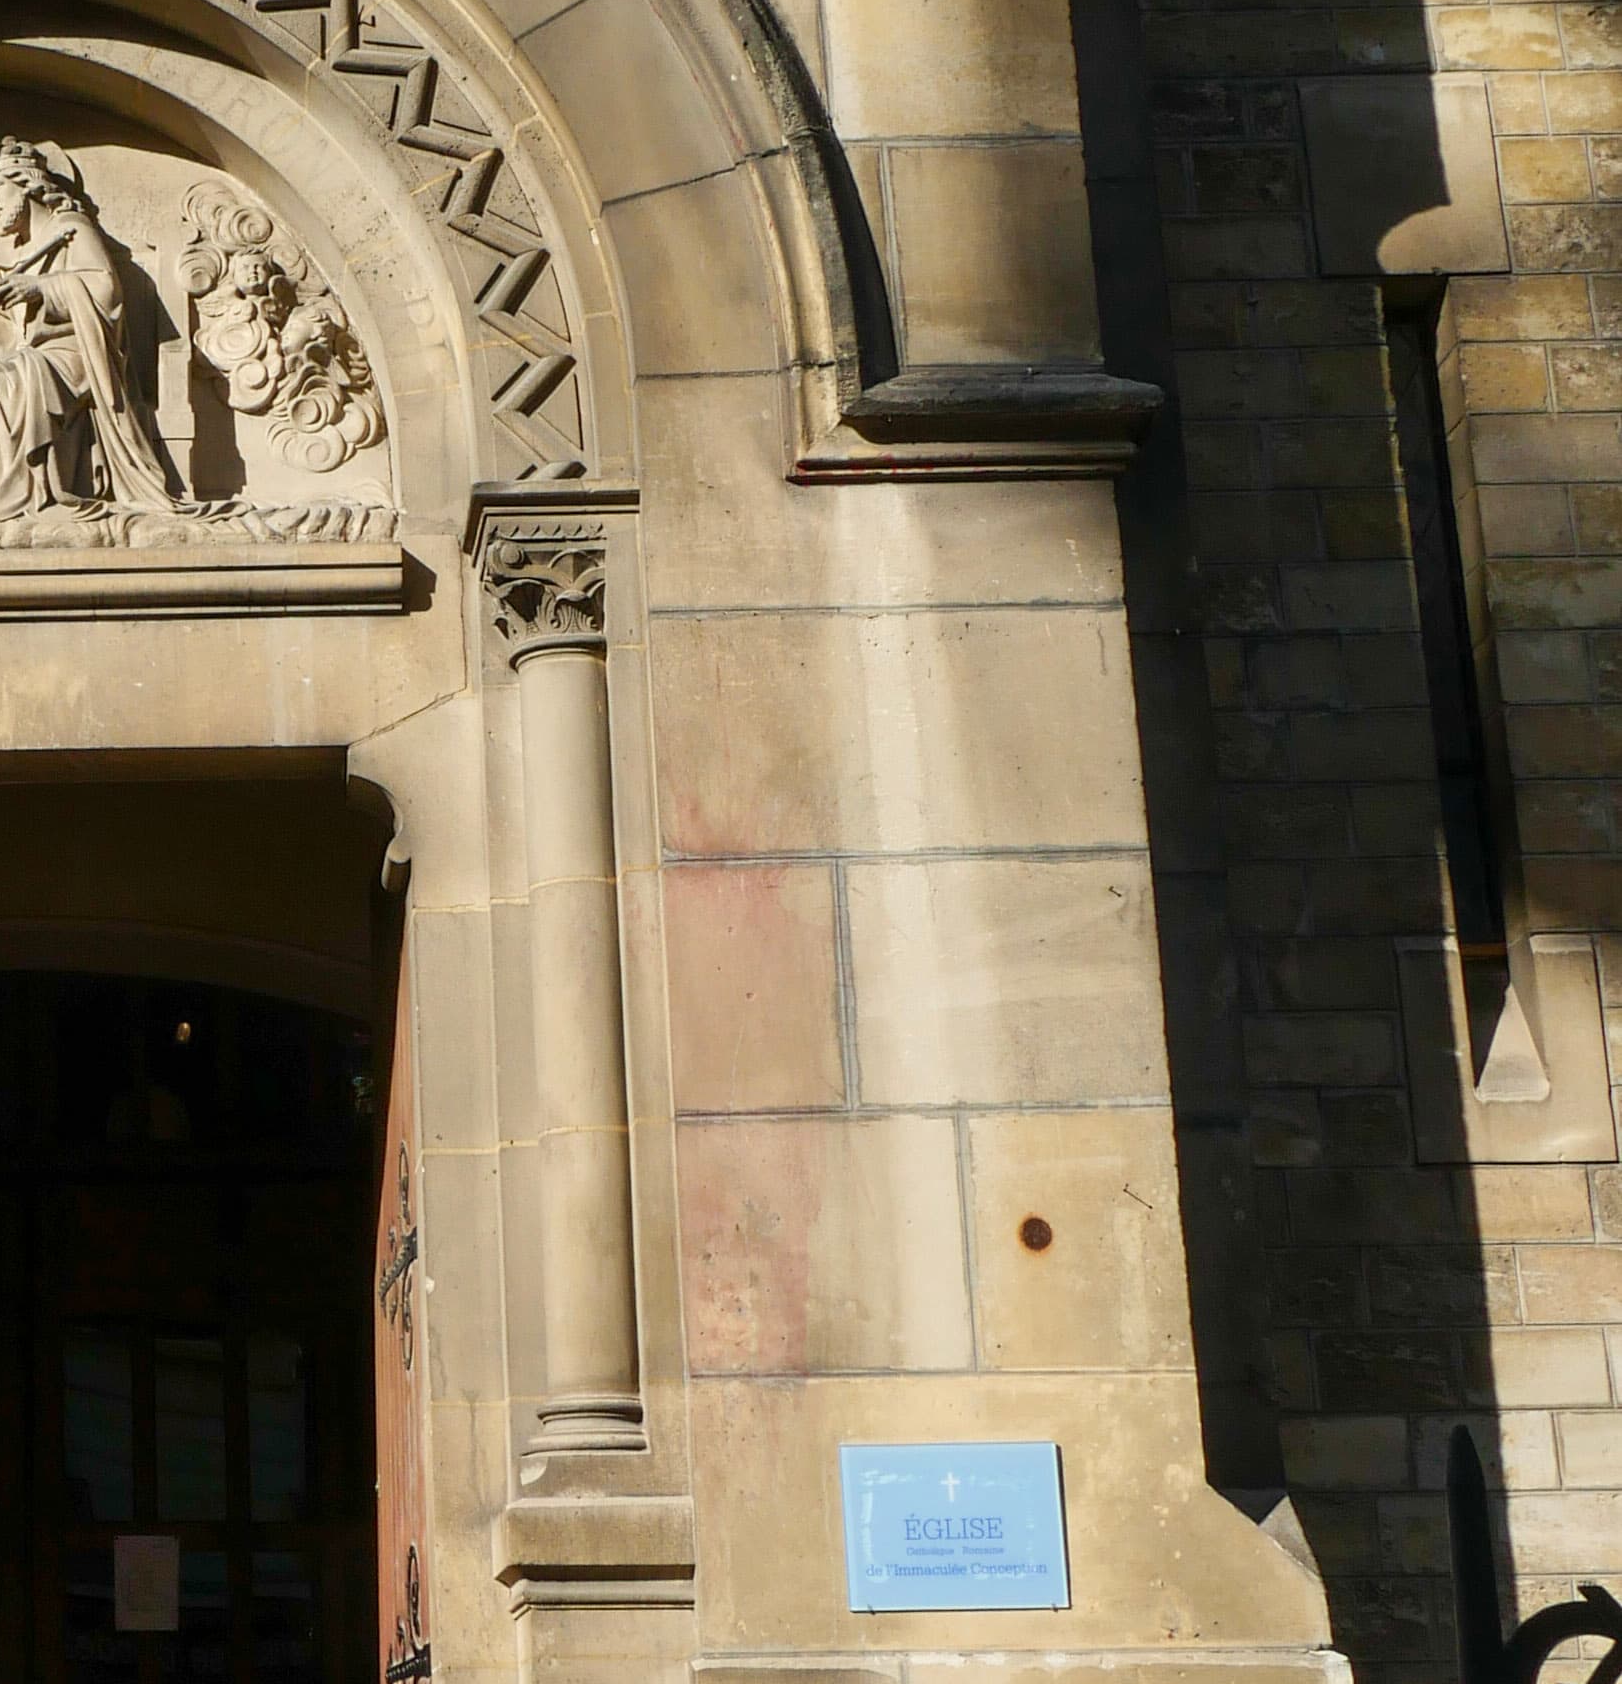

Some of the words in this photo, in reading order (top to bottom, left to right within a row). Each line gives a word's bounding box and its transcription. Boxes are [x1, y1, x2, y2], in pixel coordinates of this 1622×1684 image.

[904, 1513, 1004, 1541] ÉGLISE
[906, 1546, 954, 1557] Catholique
[962, 1546, 1004, 1555] Romaine
[866, 1563, 882, 1577] de
[885, 1562, 967, 1577] l'Immaculée
[970, 1561, 1047, 1579] Conception
